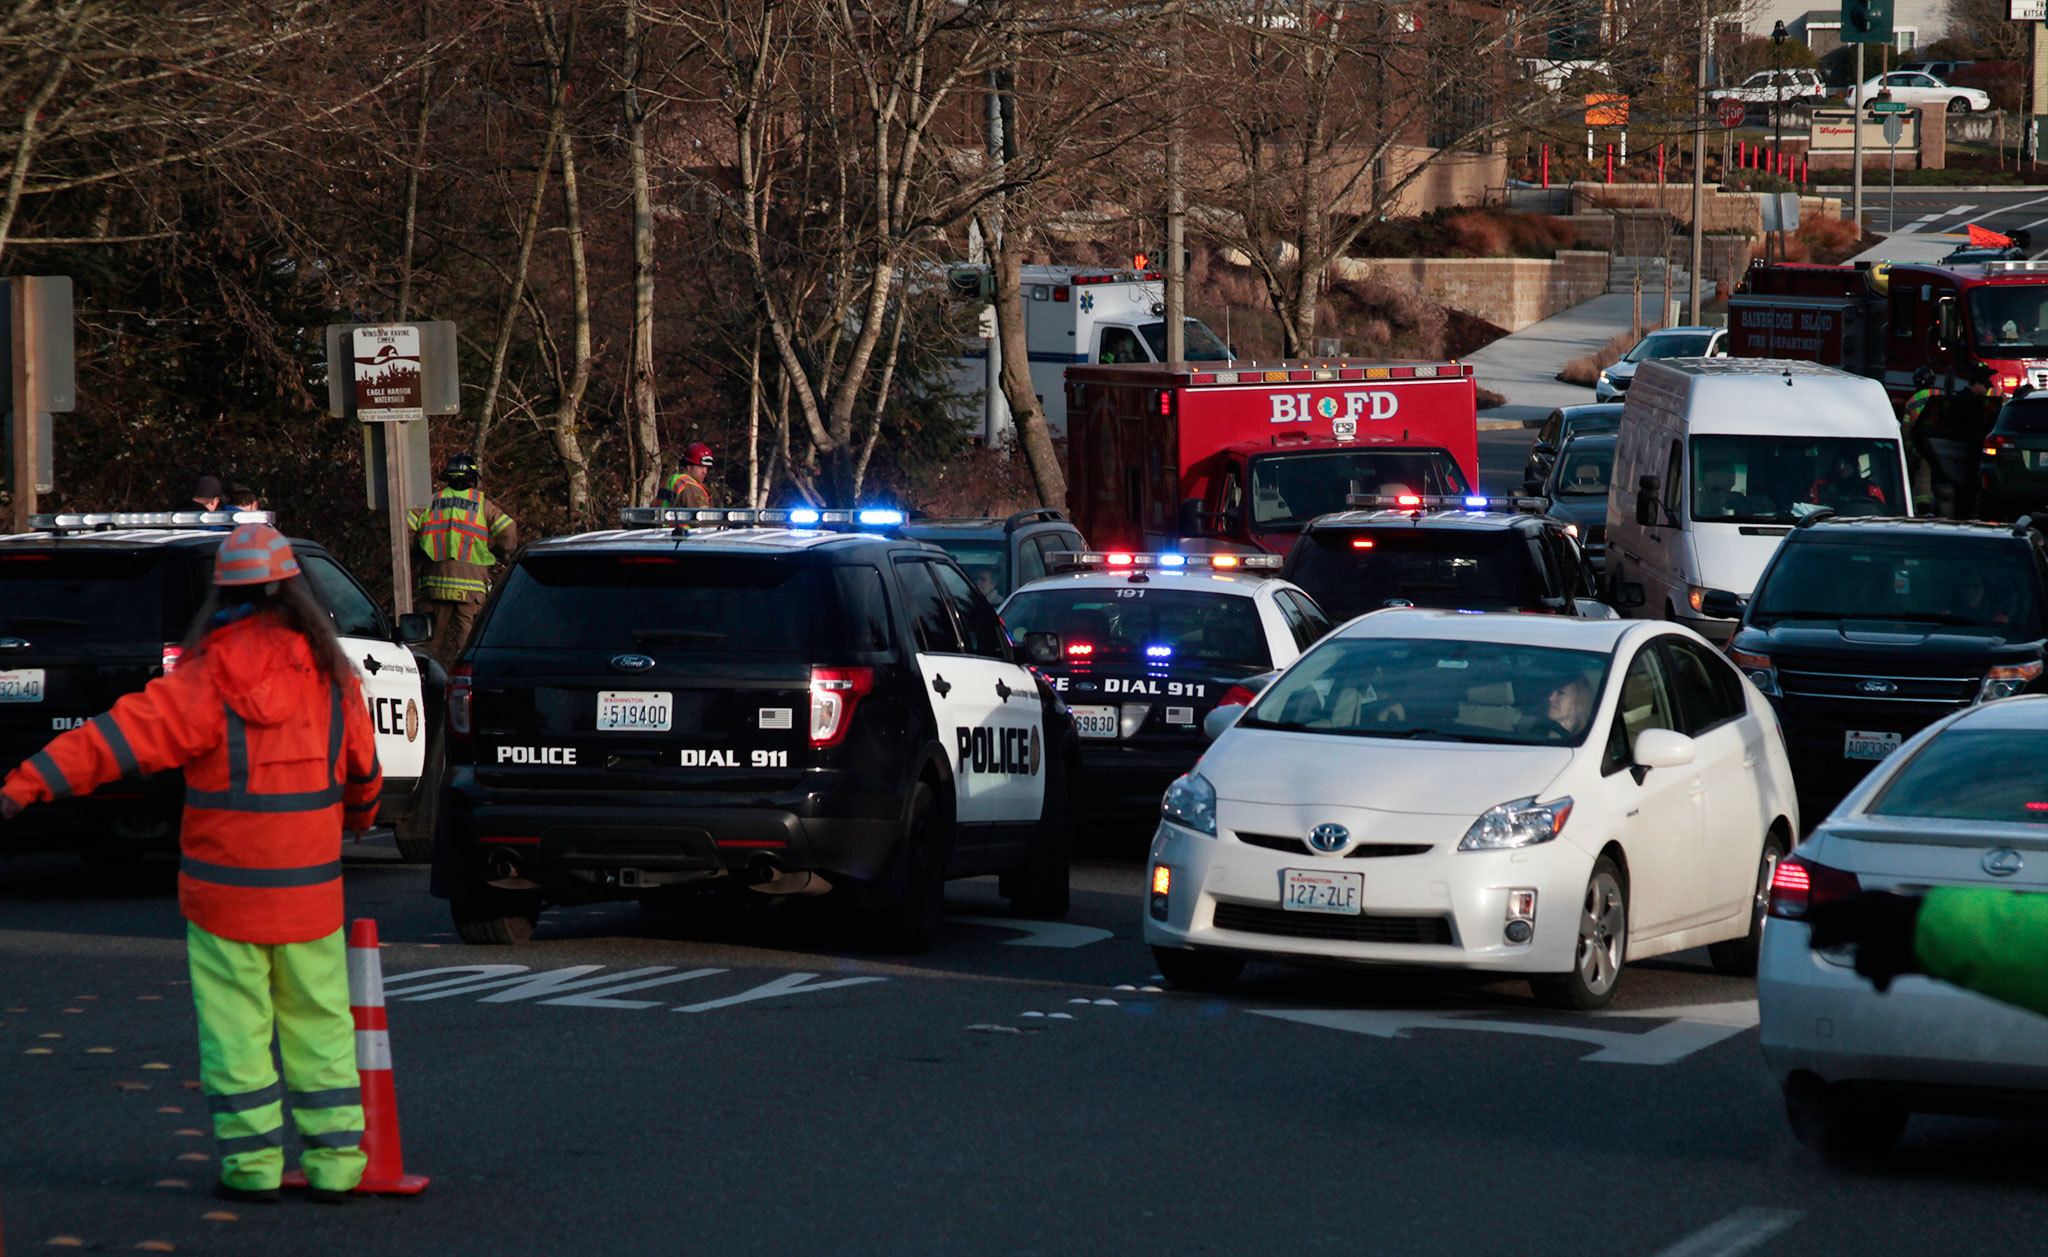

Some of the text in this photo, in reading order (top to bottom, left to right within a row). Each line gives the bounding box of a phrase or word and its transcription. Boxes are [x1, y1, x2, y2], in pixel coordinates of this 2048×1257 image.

[1718, 104, 1743, 124] STOP
[1741, 311, 1833, 332] BAINBRIDGE ISLAND
[1747, 334, 1825, 352] FIRE DEPARTMENT
[366, 387, 412, 396] EAGLE HARBOR
[373, 396, 405, 404] WATERSHED
[1343, 391, 1400, 421] FD
[1115, 588, 1145, 598] 191
[1104, 677, 1161, 695] DIAL
[1167, 681, 1205, 698] 911
[52, 717, 94, 731] DIA
[367, 696, 405, 735] ICE
[610, 705, 667, 724] 51940D
[1075, 715, 1114, 733] 6983D
[497, 746, 788, 768] POLICE DIAL 911
[956, 726, 1029, 775] POLICE
[1290, 884, 1356, 907] 127-ZLF
[383, 964, 889, 1013] ONLY
